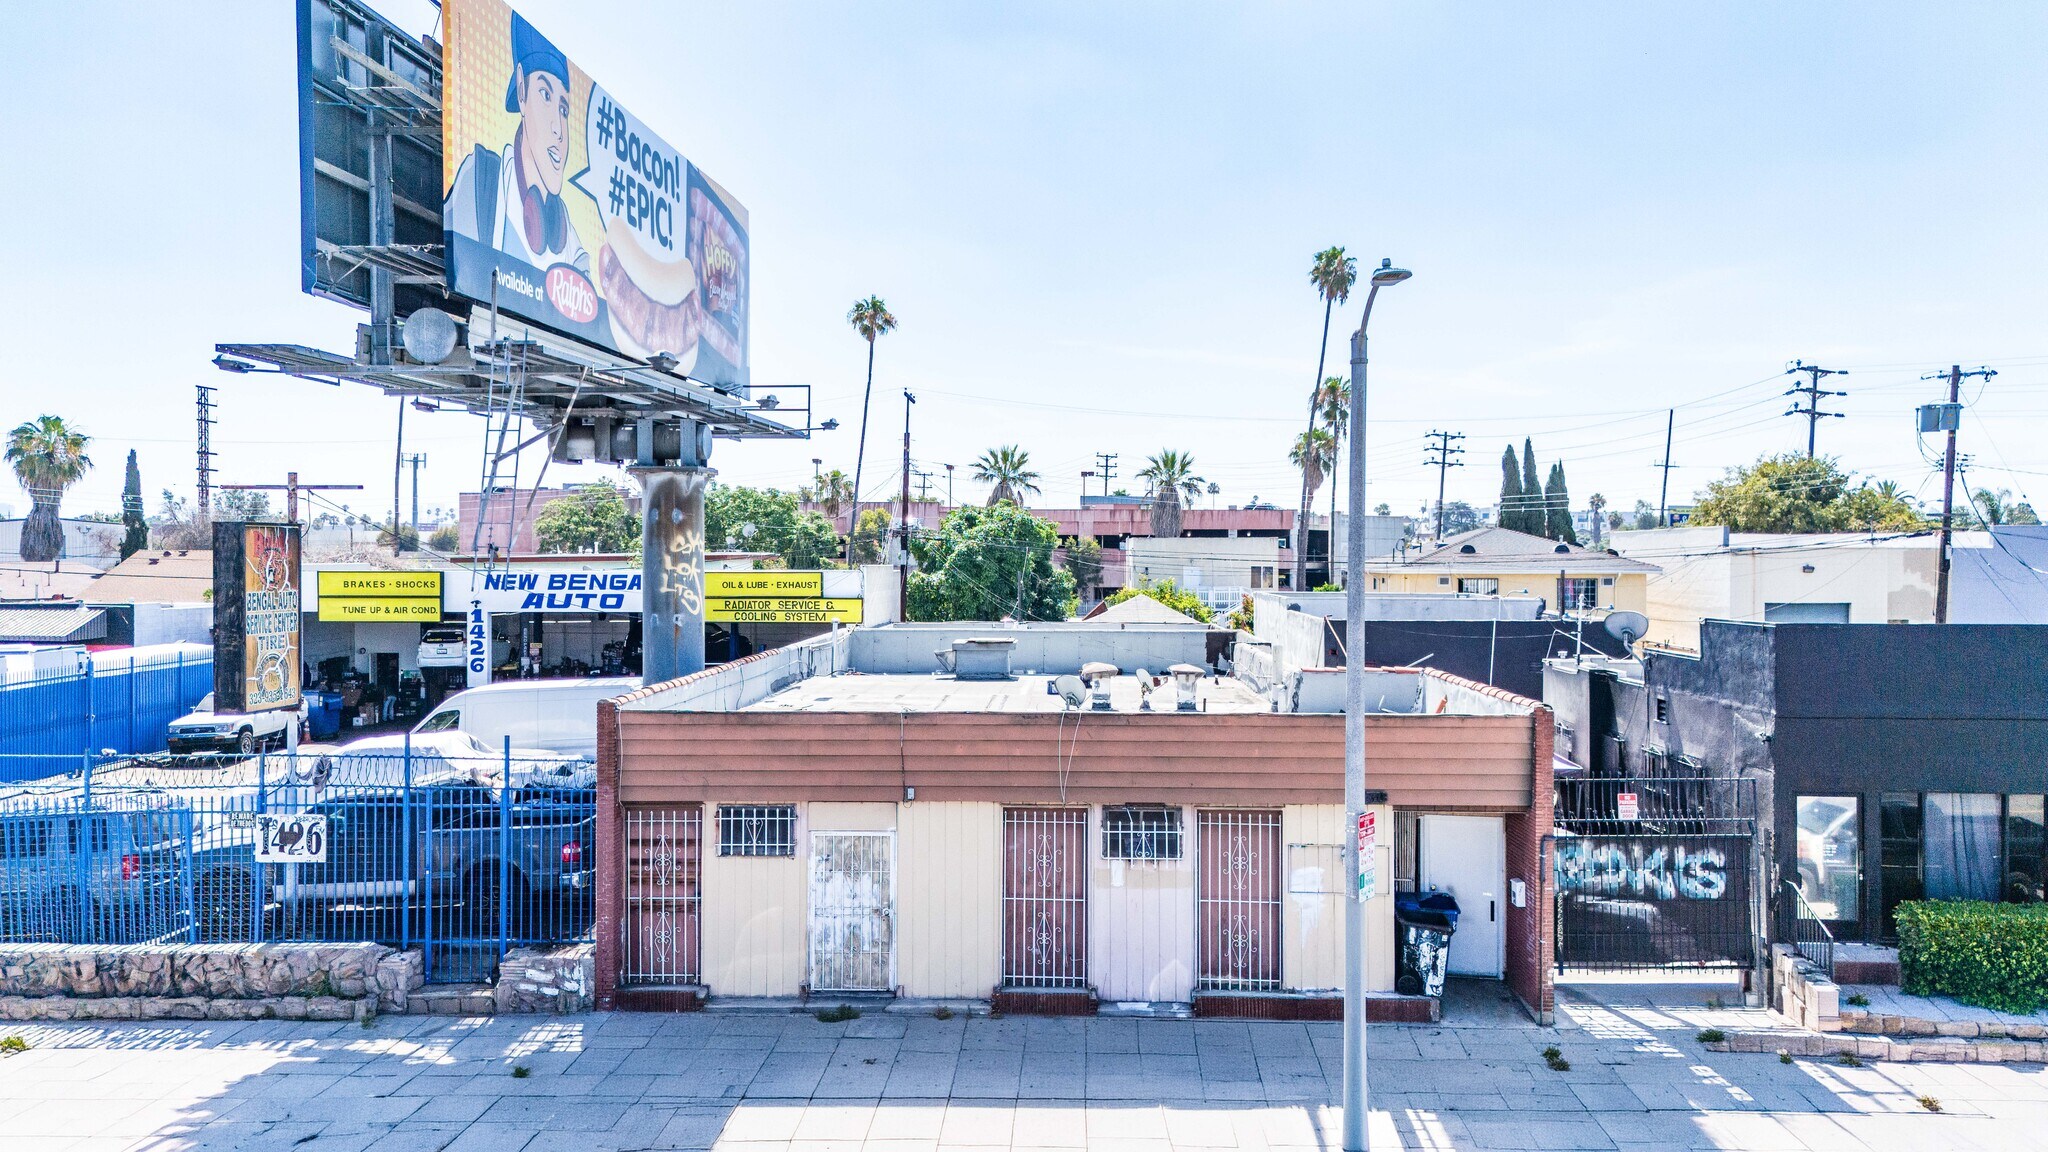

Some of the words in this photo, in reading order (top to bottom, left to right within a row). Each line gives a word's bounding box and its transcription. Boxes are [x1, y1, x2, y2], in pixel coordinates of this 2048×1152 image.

[596, 95, 680, 204] #Bacon!
[608, 165, 673, 251] #EPIC!
[705, 243, 736, 279] HOFFY
[535, 285, 544, 302] at
[552, 269, 594, 318] Ralphs
[343, 580, 386, 589] BRAKES
[395, 580, 436, 589] SHOCKS
[484, 574, 539, 591] NEW
[548, 574, 642, 591] BENGA
[721, 581, 736, 589] OIL
[737, 581, 744, 589] &
[746, 581, 768, 589] LUBE
[776, 581, 818, 589] EXHAUST
[246, 592, 276, 612] BENGAL
[277, 590, 298, 610] AUTO
[520, 593, 625, 609] AUTO
[724, 600, 771, 610] RADIATOR
[778, 600, 820, 610] SERVICE
[825, 601, 835, 610] &
[342, 606, 367, 614] TUNE
[369, 606, 382, 614] UP
[384, 606, 391, 614] &
[393, 606, 408, 614] AIR
[411, 606, 438, 615] COND.
[734, 612, 777, 621] COOLING
[784, 612, 827, 622] SYSTEM
[246, 614, 272, 635] SERVICE
[273, 612, 298, 632] CENTER
[258, 634, 285, 651] TIRE
[469, 608, 486, 673] 1426
[259, 817, 322, 855] 1426
